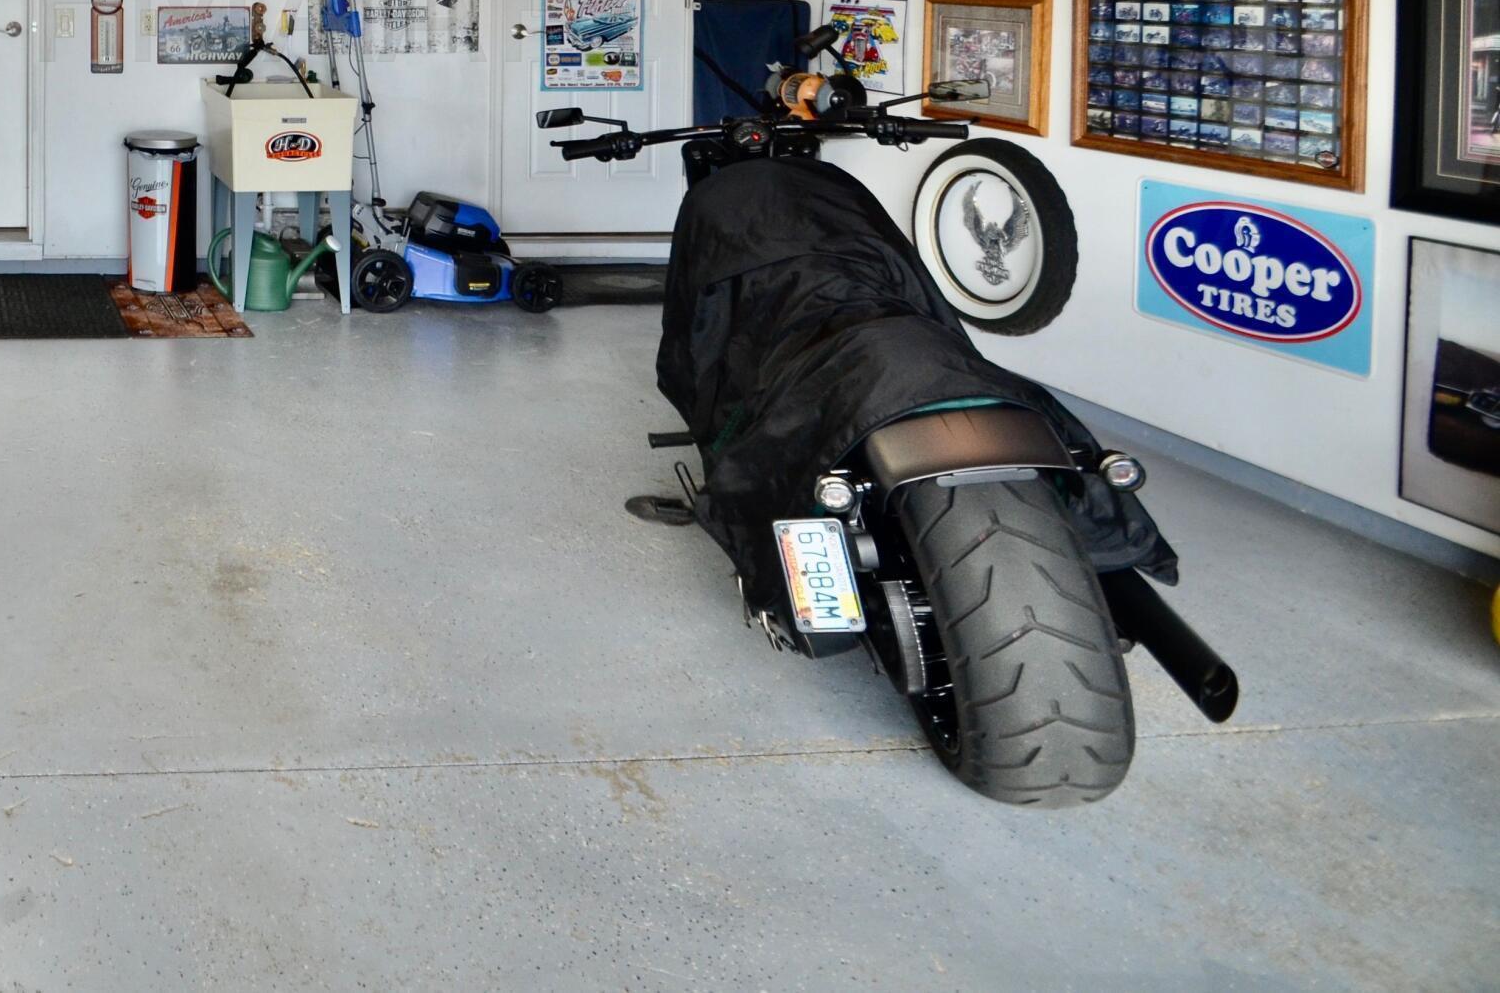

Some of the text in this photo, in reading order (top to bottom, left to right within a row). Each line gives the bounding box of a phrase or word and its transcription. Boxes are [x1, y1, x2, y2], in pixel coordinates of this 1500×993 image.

[163, 9, 213, 28] America's
[170, 44, 181, 53] 66
[185, 52, 243, 61] HIGHWAY
[1162, 225, 1343, 304] Cooper
[1196, 282, 1299, 330] TIRES
[798, 532, 842, 619] 67984M
